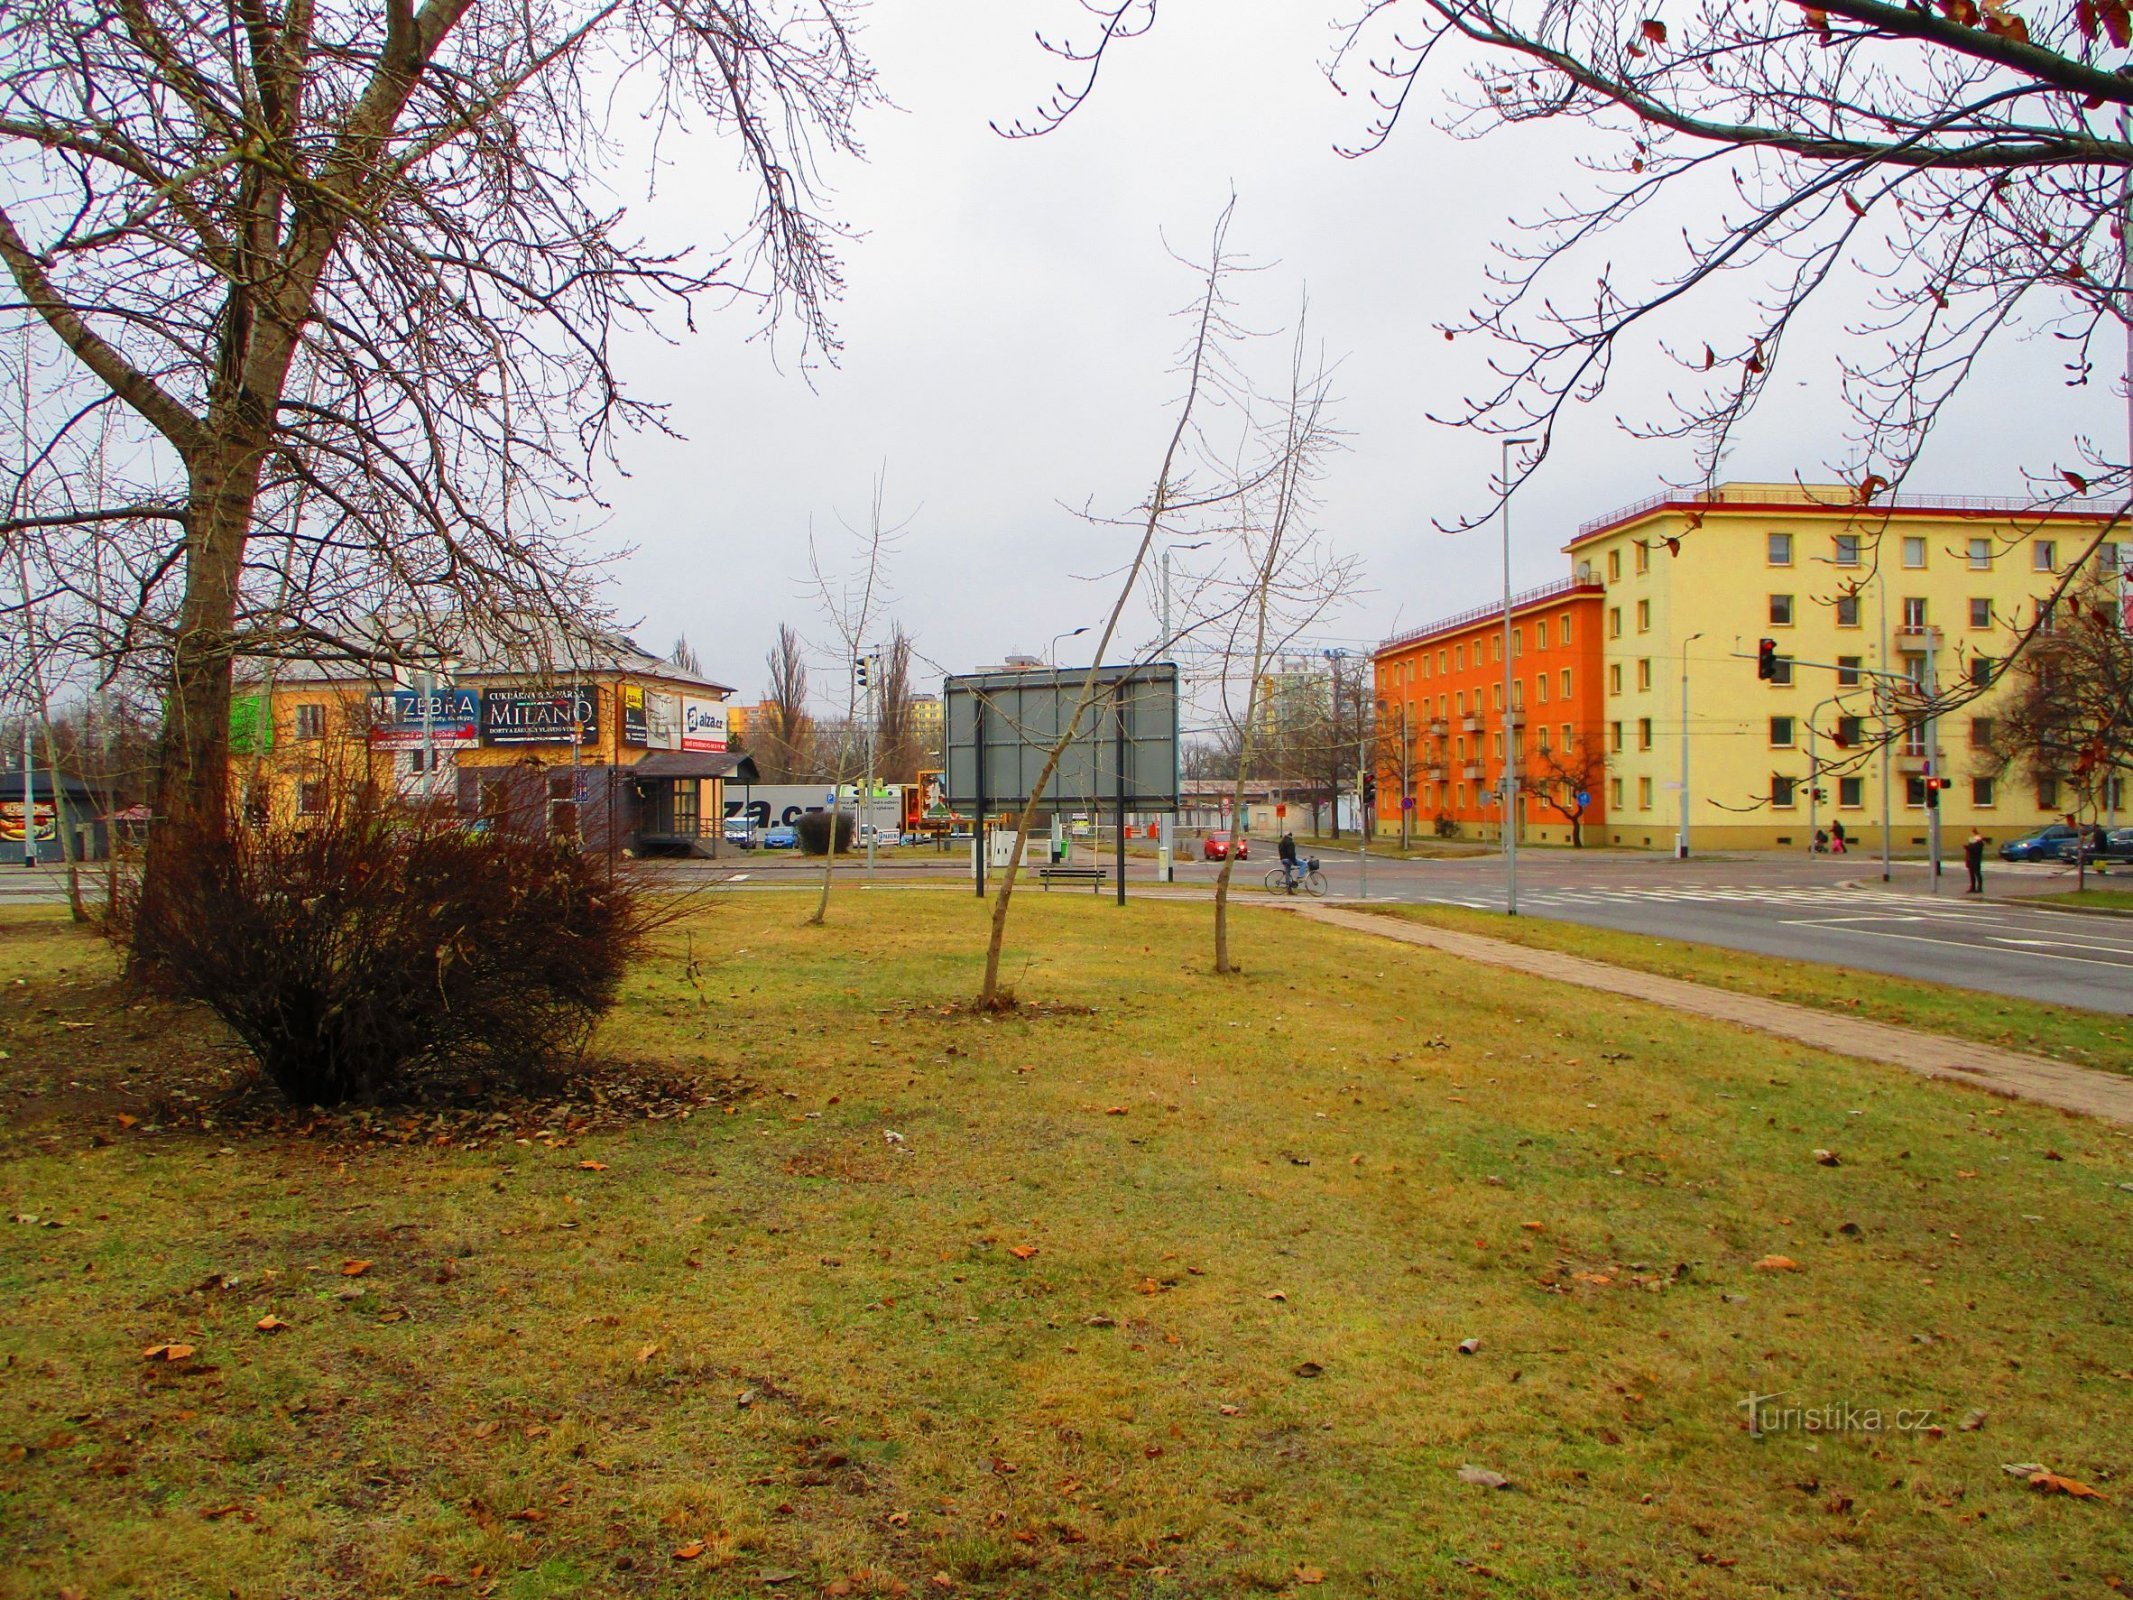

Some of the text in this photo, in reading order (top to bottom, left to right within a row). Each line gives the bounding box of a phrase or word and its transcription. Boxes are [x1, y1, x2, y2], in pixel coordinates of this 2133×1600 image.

[402, 696, 475, 716] ZEBRA
[490, 700, 593, 726] MILANO
[699, 711, 723, 730] alza.cz
